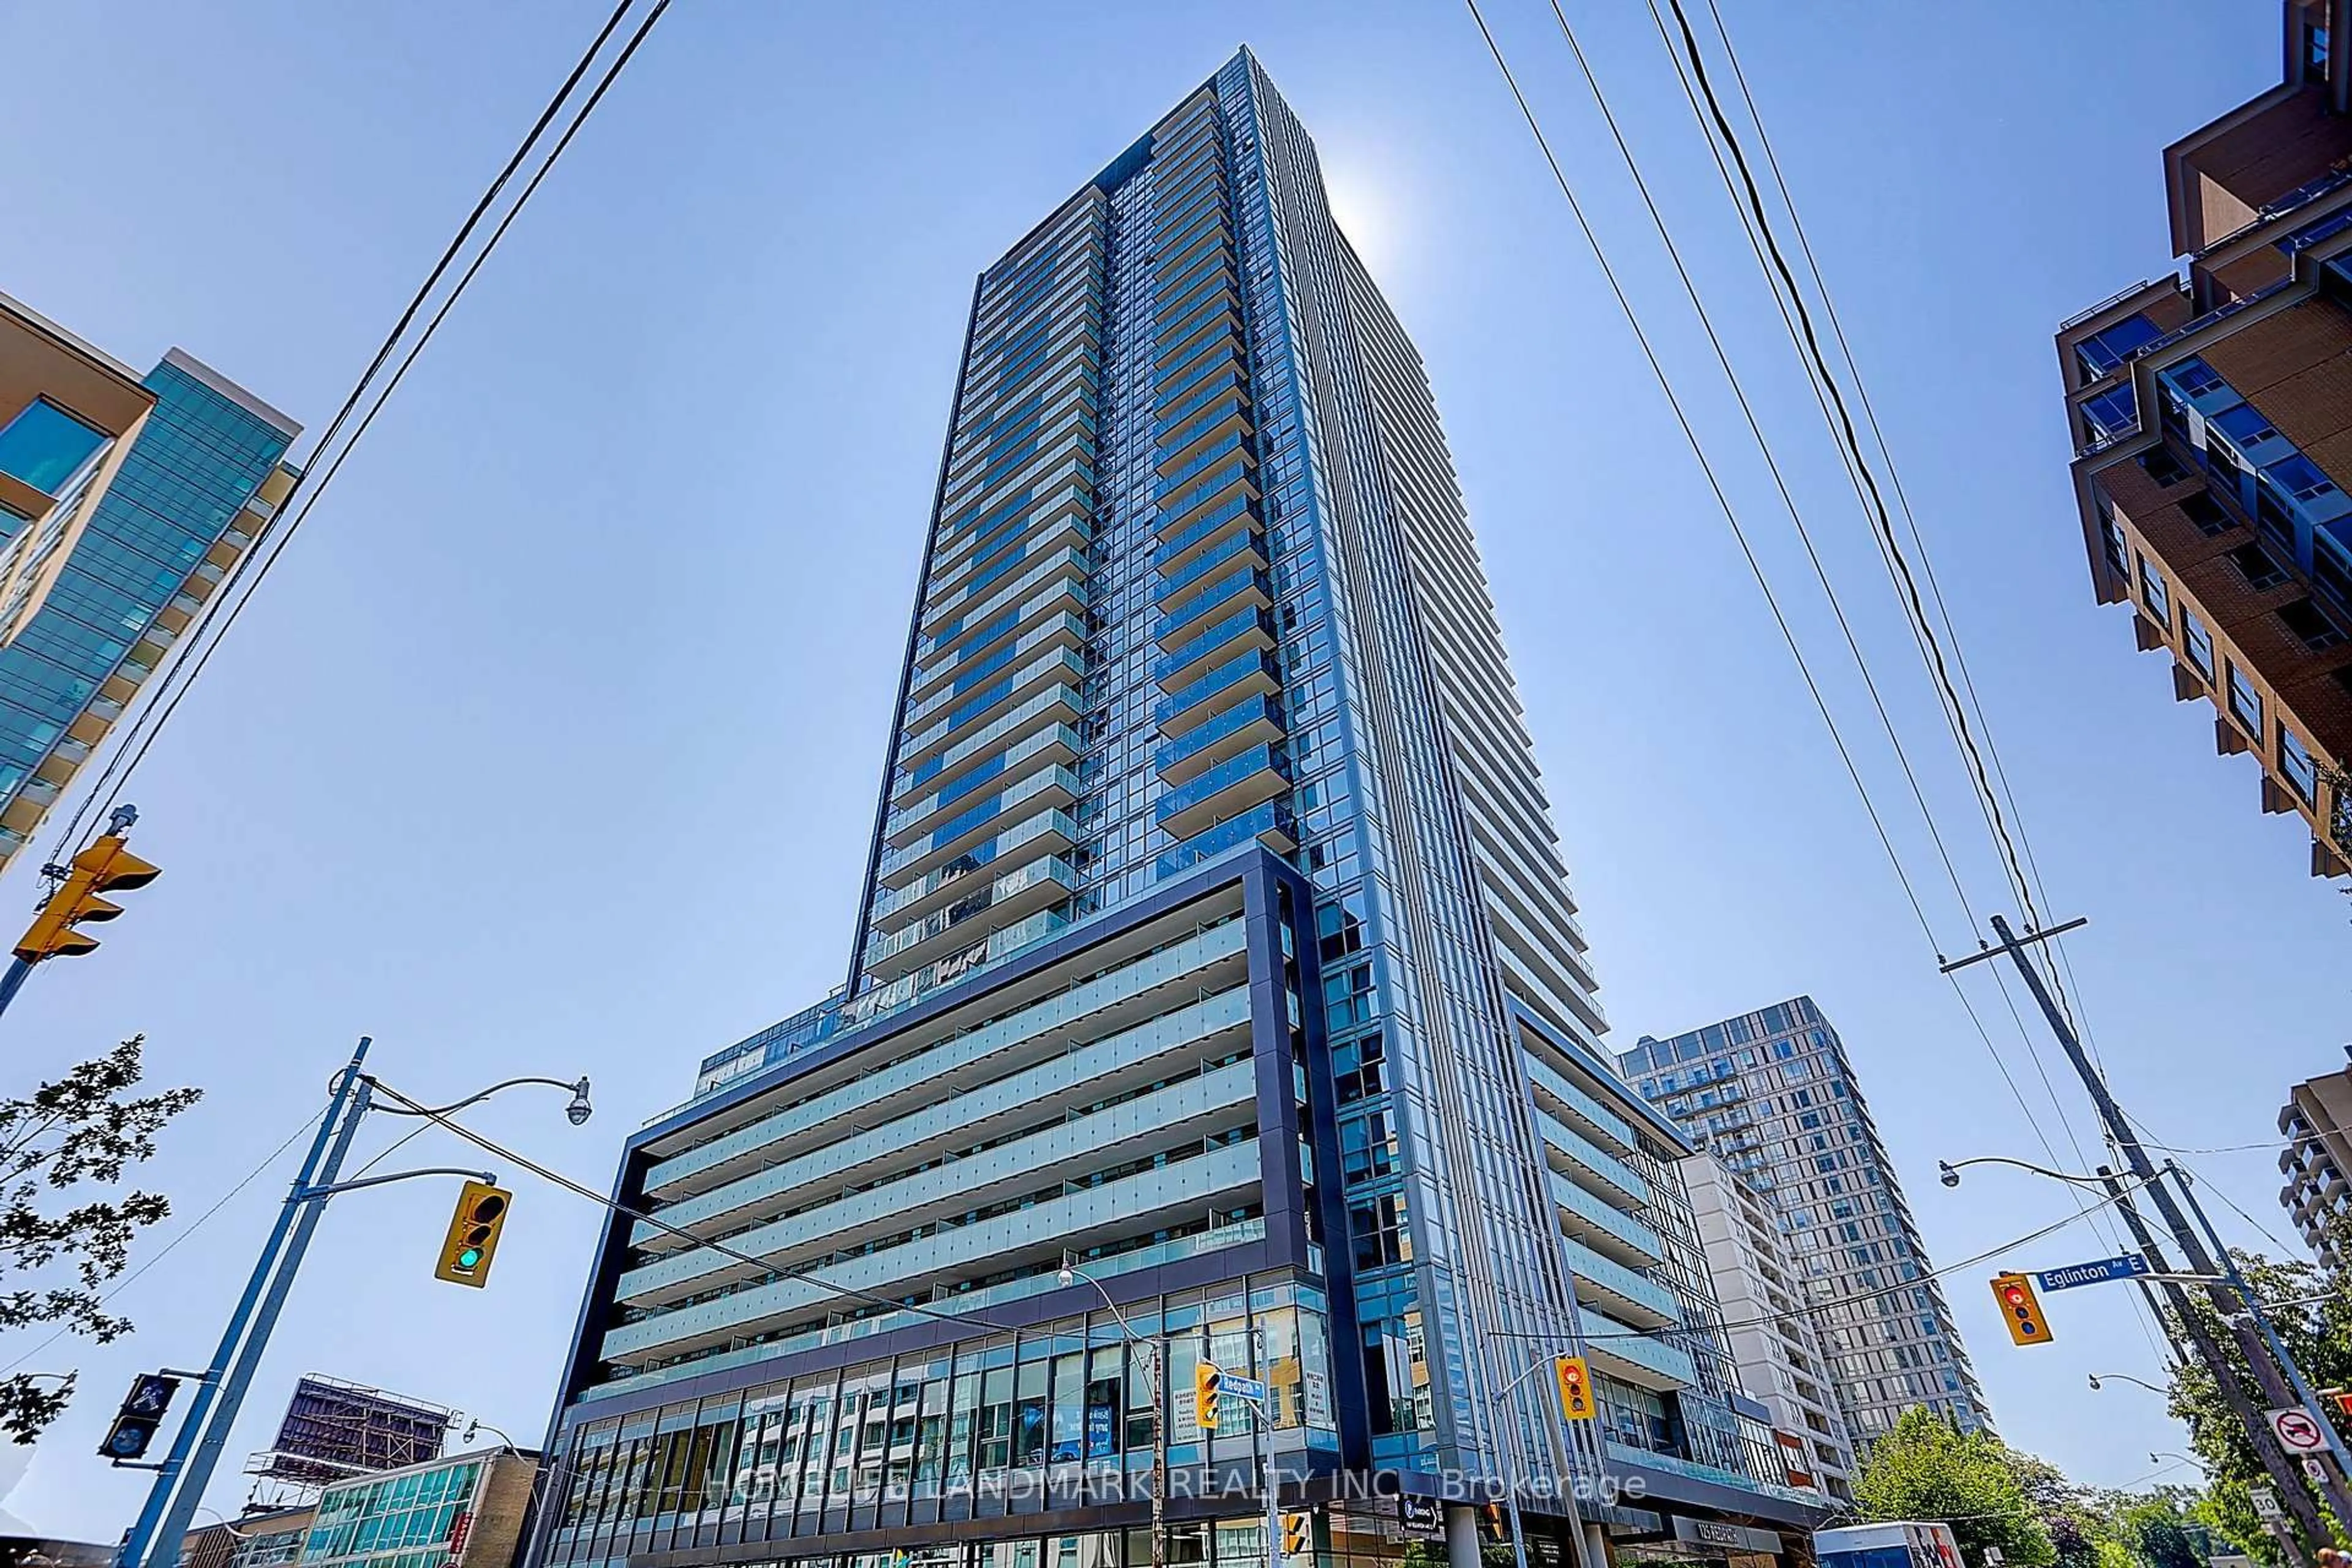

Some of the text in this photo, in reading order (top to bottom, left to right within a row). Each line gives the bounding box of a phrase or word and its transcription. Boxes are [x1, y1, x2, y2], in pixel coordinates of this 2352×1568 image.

[2043, 1265, 2109, 1288] Eglinton
[2128, 1256, 2143, 1272] E
[1223, 1376, 1254, 1395] Redpath
[2255, 1498, 2275, 1510] 30
